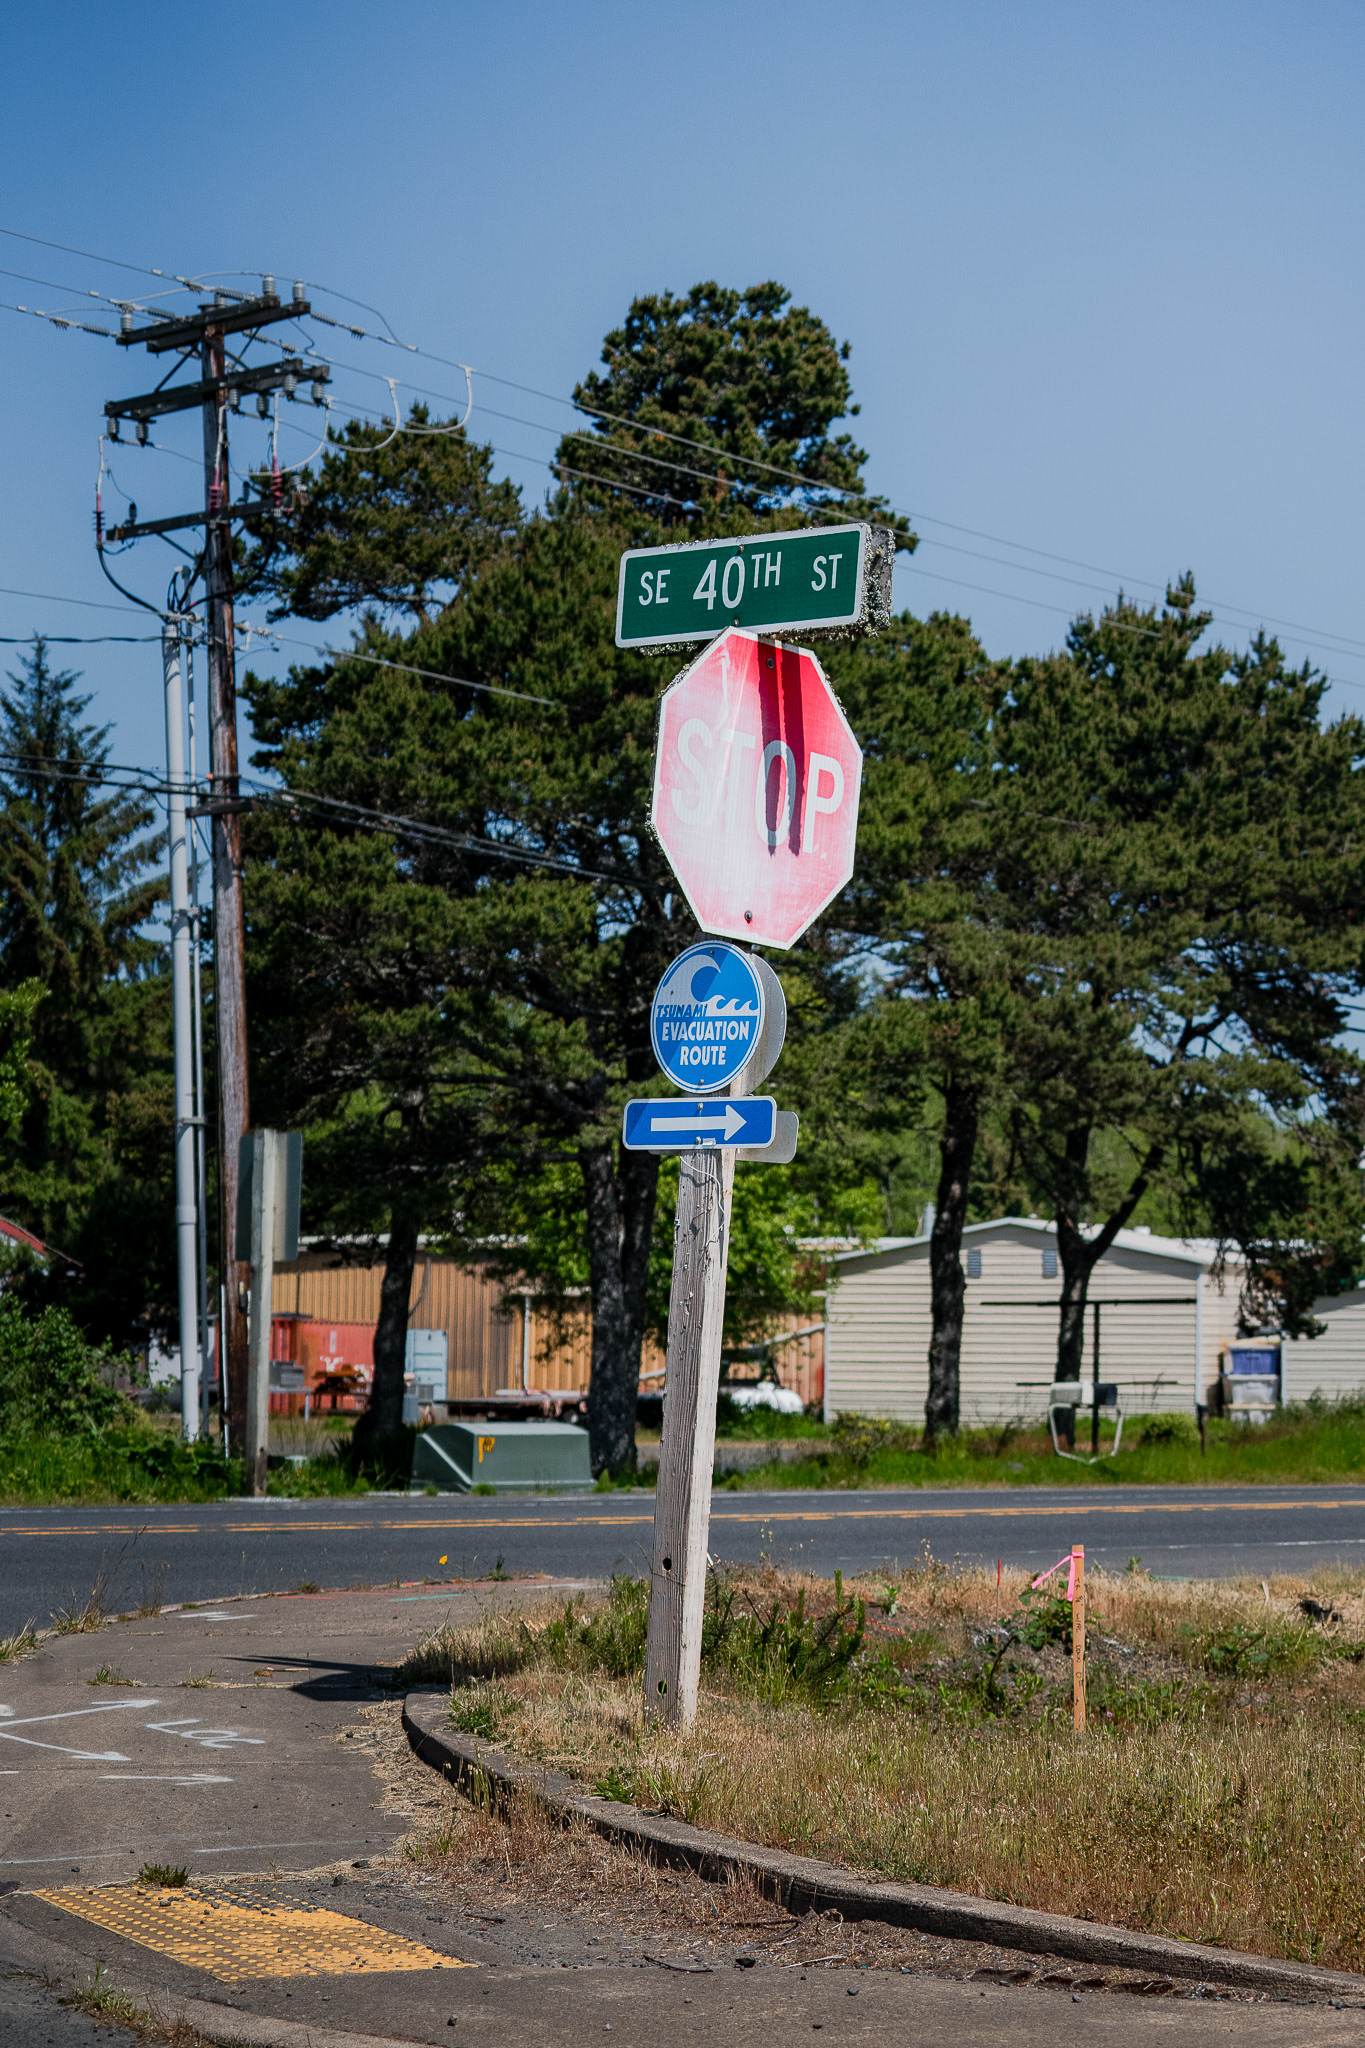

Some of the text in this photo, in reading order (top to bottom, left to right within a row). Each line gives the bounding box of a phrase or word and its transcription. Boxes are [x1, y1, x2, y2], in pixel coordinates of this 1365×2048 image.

[638, 551, 843, 610] SE 40TH ST
[670, 717, 845, 854] STOP
[655, 1004, 708, 1018] TSUNAMI
[661, 1020, 750, 1041] EVACUATION
[679, 1045, 727, 1066] ROUTE
